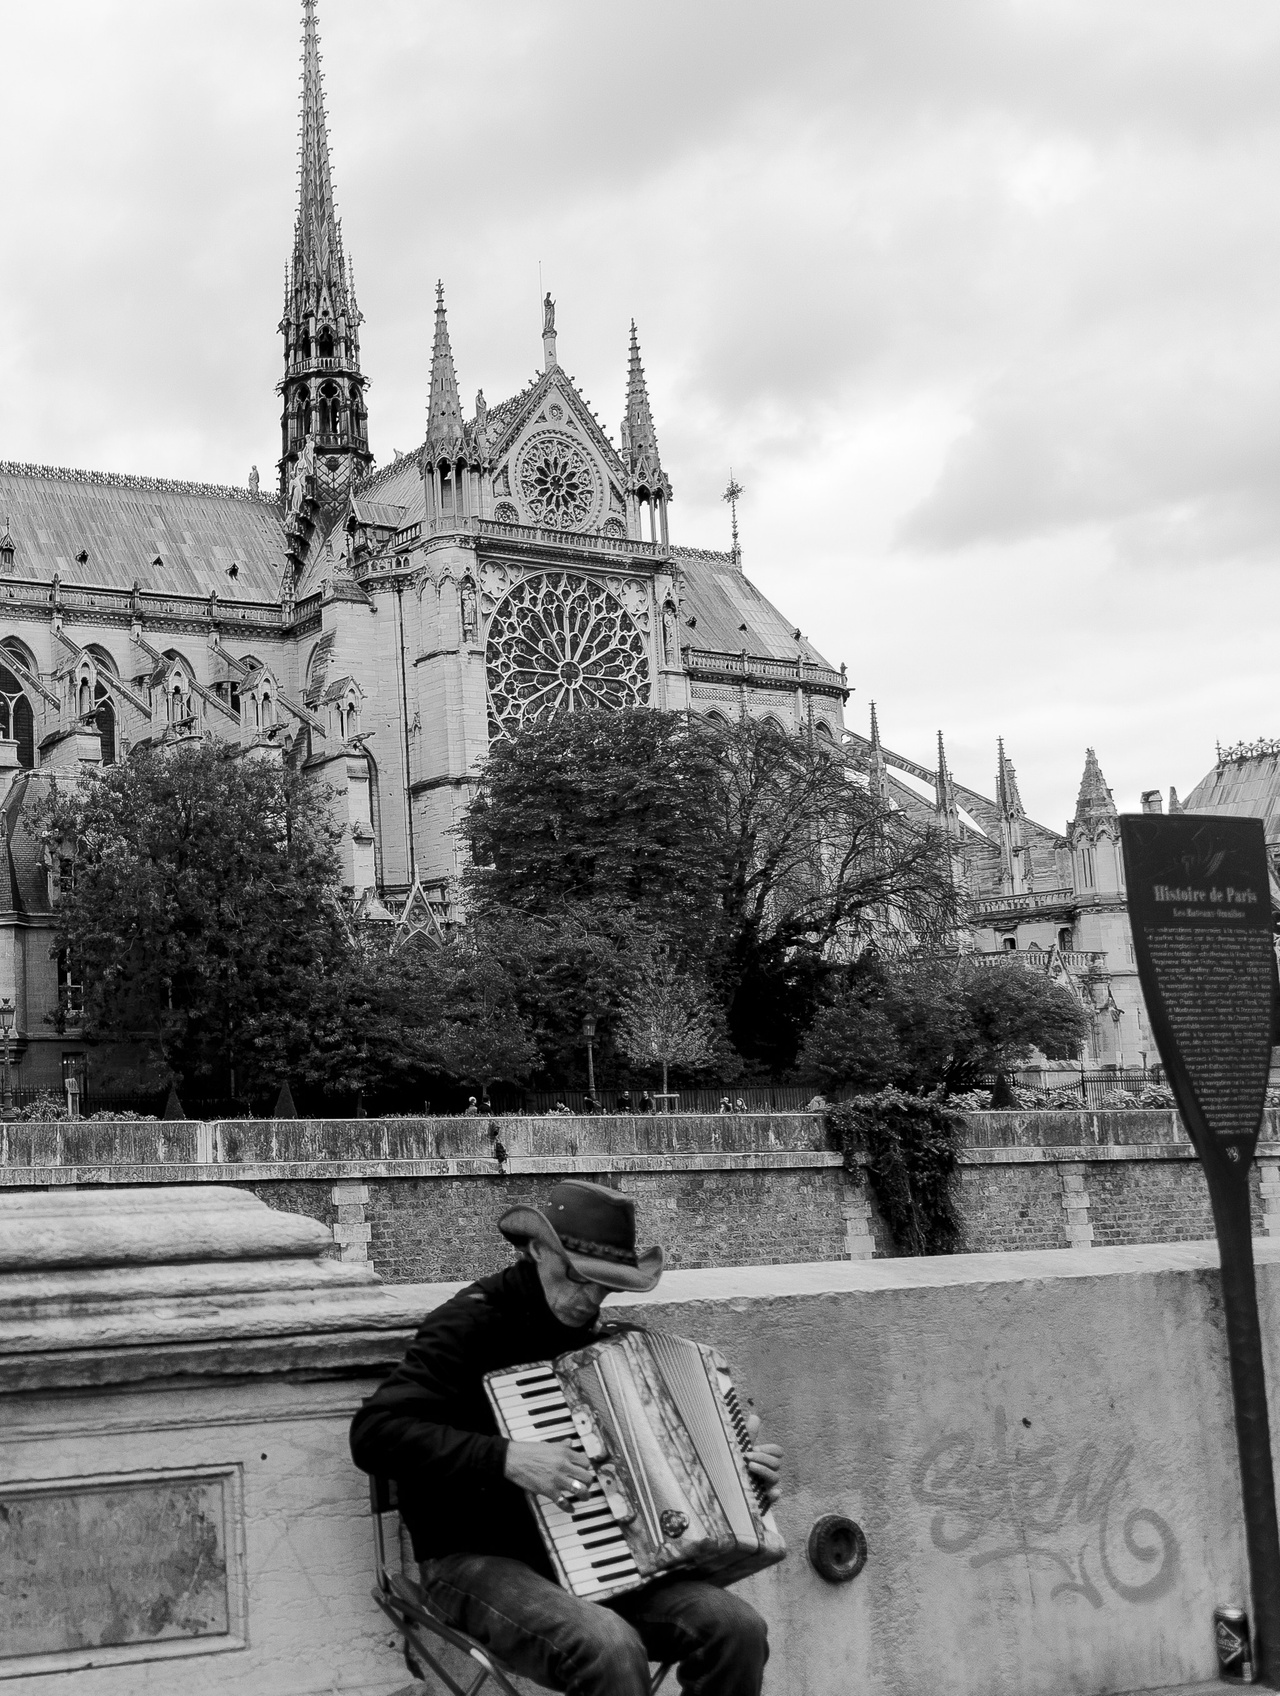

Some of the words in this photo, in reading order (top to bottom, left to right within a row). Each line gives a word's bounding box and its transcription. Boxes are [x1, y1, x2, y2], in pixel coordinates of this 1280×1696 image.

[1153, 885, 1207, 902] Histoire
[1209, 886, 1224, 903] de
[1226, 886, 1258, 904] Paris
